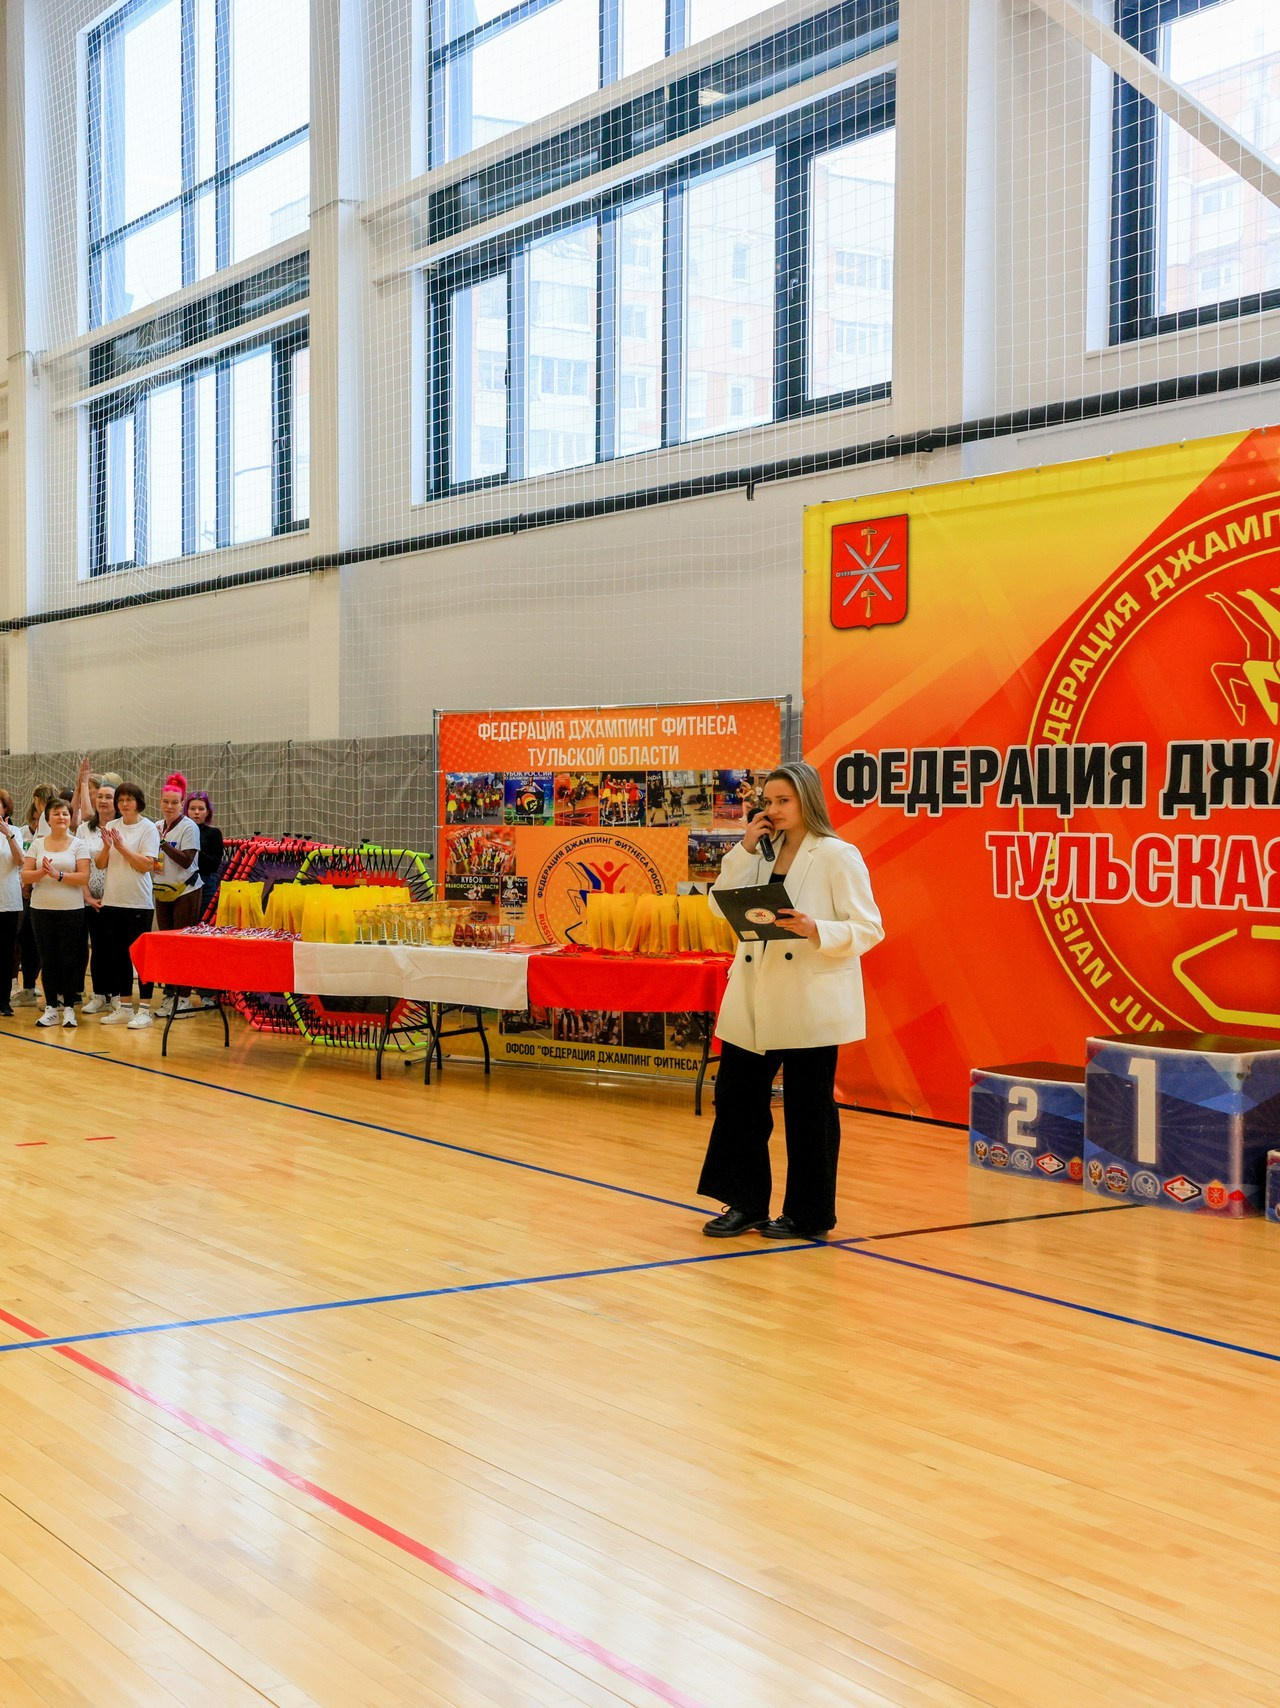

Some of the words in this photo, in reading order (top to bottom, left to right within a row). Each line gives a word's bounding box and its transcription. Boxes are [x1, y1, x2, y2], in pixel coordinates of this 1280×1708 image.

[1042, 592, 1141, 744] ДЕРАЦИЯ
[478, 720, 565, 743] ФЕДЕРАЦИЯ
[568, 717, 658, 741] ДЖАМПИНГ
[661, 714, 738, 737] ФИТНЕСА
[527, 744, 606, 767] ТУЛЬСКОЙ
[609, 745, 680, 766] ОБЛАСТИ
[835, 742, 1147, 817] ФЕДЕРАЦИЯ
[1159, 738, 1280, 819] ДЖ
[461, 876, 483, 884] КУБОК
[537, 849, 565, 898] ФЕДЕРАЦИЯ
[565, 836, 613, 853] ДЖАМПИНГ
[615, 840, 649, 867] ФИТНЕСА
[505, 1042, 535, 1056] ОФСОО
[537, 1045, 596, 1062] "ФЕДЕРАЦИЯ
[597, 1050, 652, 1067] ДЖАМПИНГ
[1007, 1085, 1038, 1148] 2
[1127, 1057, 1156, 1164] 1
